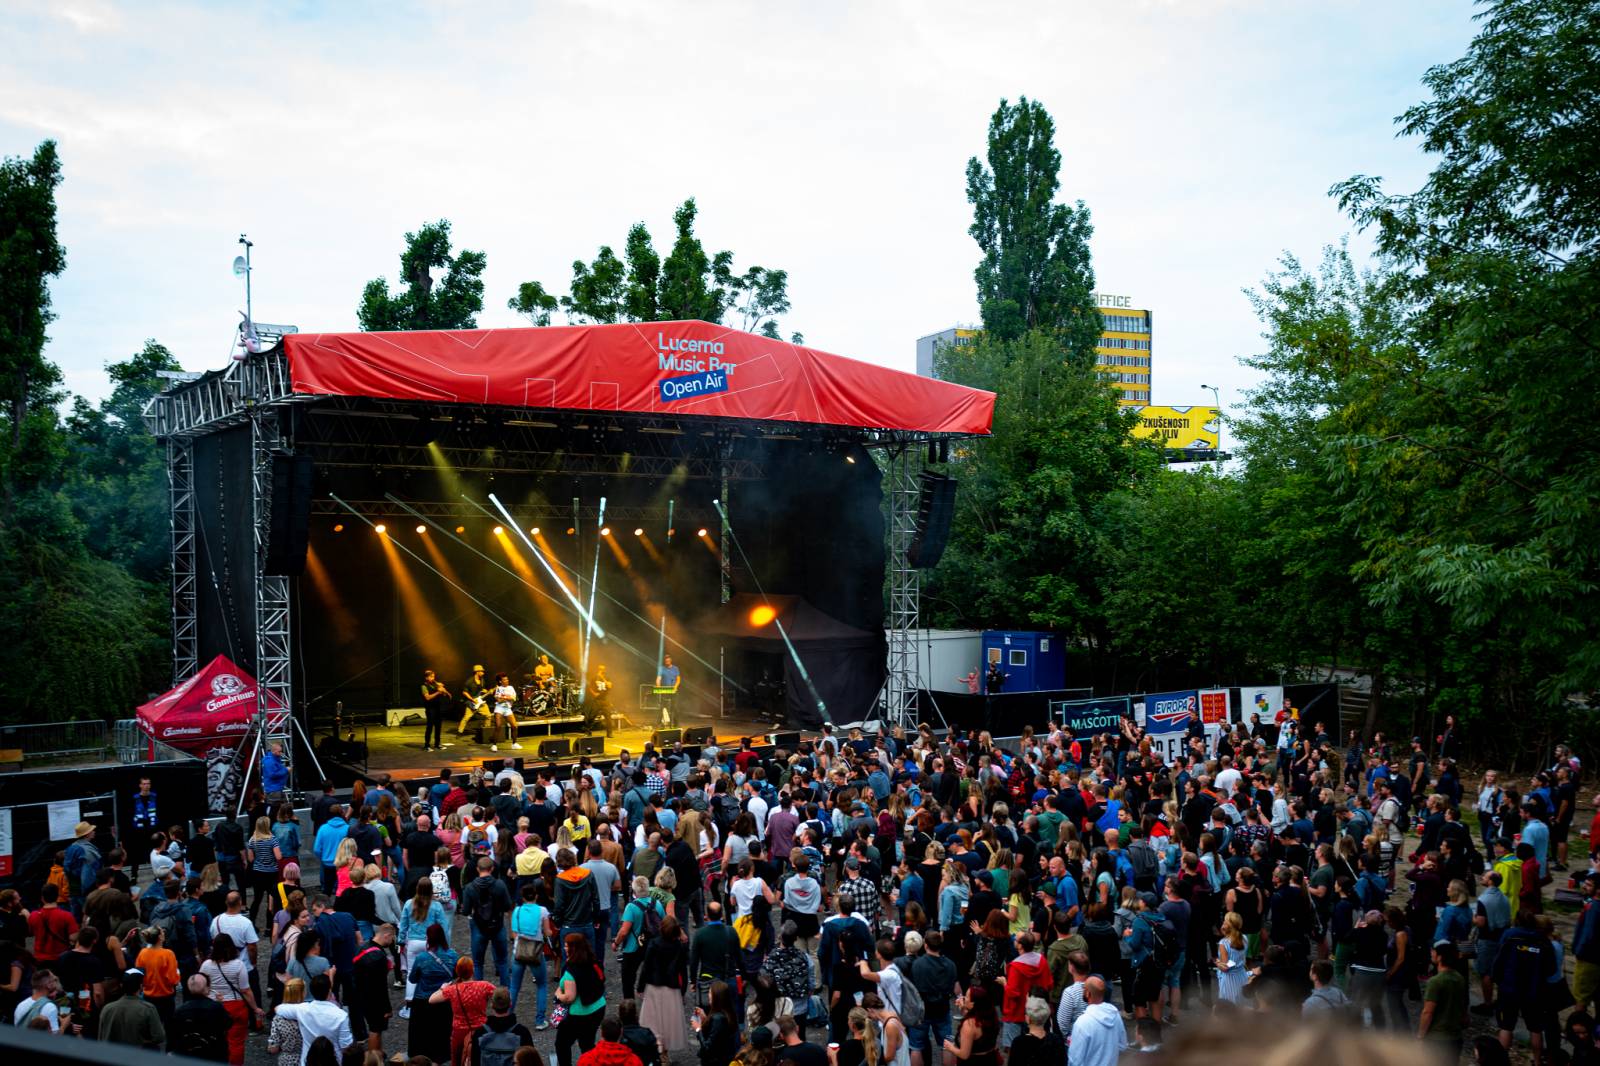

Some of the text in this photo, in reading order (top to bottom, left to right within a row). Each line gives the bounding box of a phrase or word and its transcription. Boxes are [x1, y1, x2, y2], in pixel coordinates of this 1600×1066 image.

[658, 332, 724, 355] Lucerna
[658, 352, 737, 375] Music Bar
[663, 372, 724, 398] Open Air
[1143, 416, 1190, 429] ZKUŠENOSTI
[1162, 428, 1179, 439] VLIV
[206, 690, 256, 712] Gambrinus
[1155, 698, 1188, 714] EVROPA
